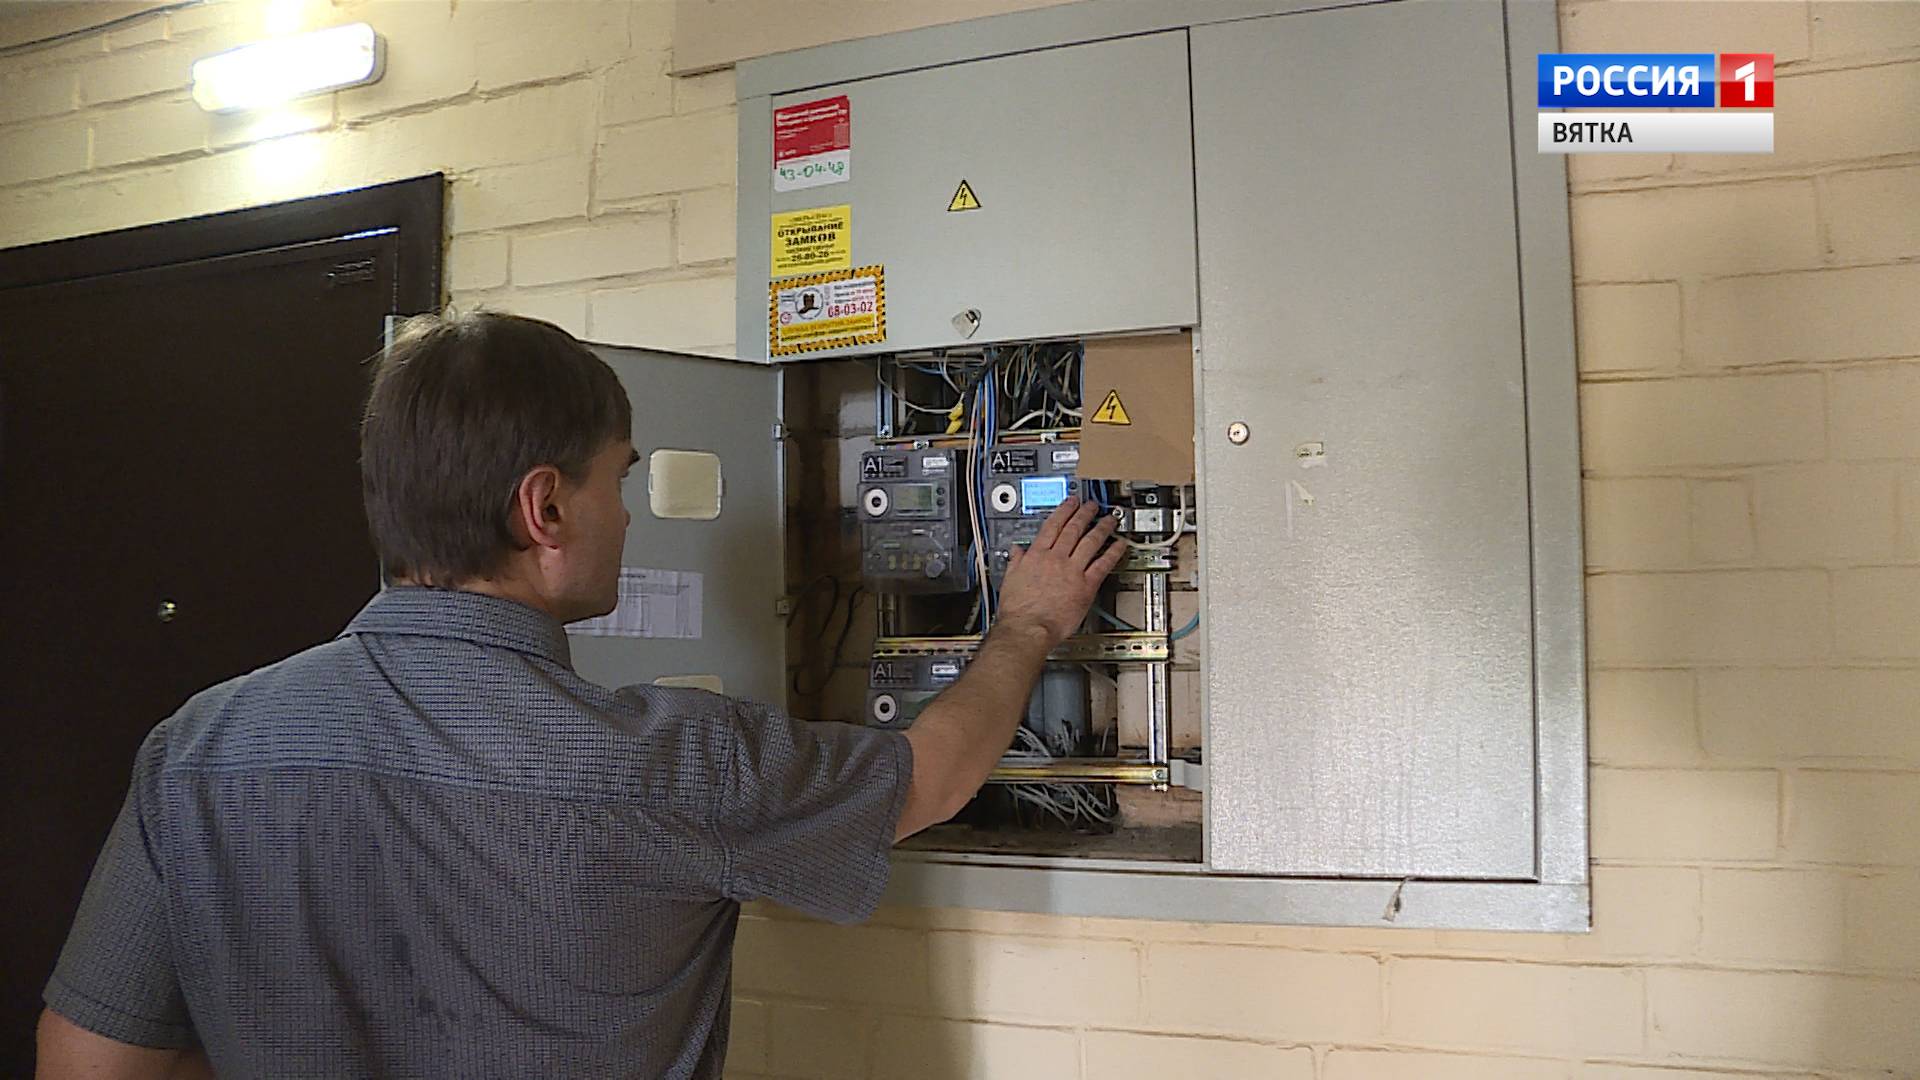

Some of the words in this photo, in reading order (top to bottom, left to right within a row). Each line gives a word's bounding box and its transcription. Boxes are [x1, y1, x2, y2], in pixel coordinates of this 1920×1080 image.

[777, 221, 844, 238] ОТКРЫВАНИЕ
[785, 232, 836, 246] ЗАМКОВ
[864, 457, 883, 472] A1
[993, 451, 1011, 468] A1
[874, 663, 893, 678] A1
